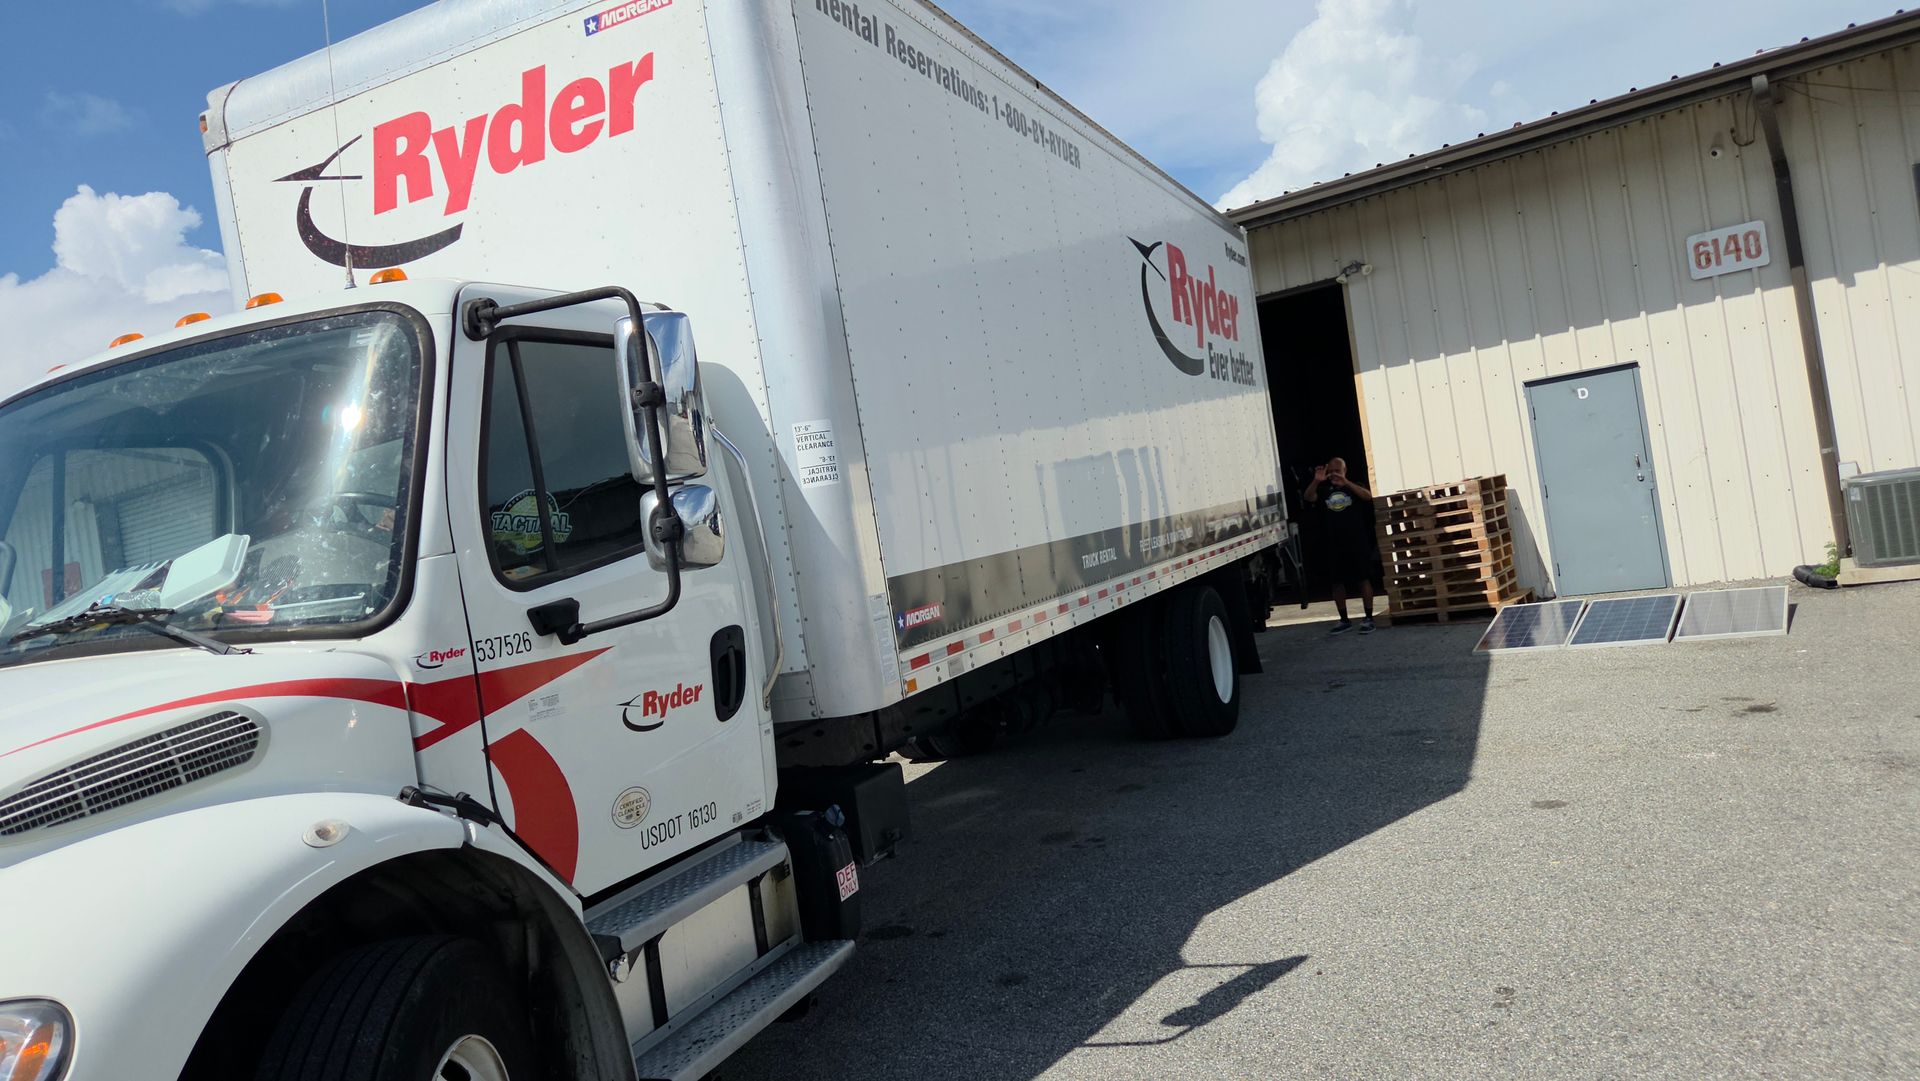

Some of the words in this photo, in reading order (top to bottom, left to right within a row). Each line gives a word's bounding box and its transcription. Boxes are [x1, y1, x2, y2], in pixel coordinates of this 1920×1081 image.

[884, 22, 989, 114] Reservations:
[992, 95, 1081, 169] 1-800-BY-RYDER
[373, 51, 654, 216] Ryder
[1693, 229, 1762, 270] 6140
[1166, 241, 1239, 349] Ryder
[1208, 341, 1230, 382] Ever
[1229, 348, 1256, 387] better.
[1577, 387, 1589, 400] D
[796, 433, 827, 443] VERTICAL
[797, 440, 834, 451] CLEARANCE
[493, 513, 571, 533] TACTIAL
[1082, 553, 1099, 569] TRUCK
[1099, 547, 1117, 564] RENTAL
[906, 605, 941, 626] MORGAN
[429, 647, 466, 663] Ryder
[475, 631, 532, 662] 537526
[642, 683, 703, 718] Ryder
[640, 814, 683, 850] USDOT
[688, 801, 717, 830] 16130
[838, 864, 855, 887] DEF
[841, 879, 858, 898] ONLY
